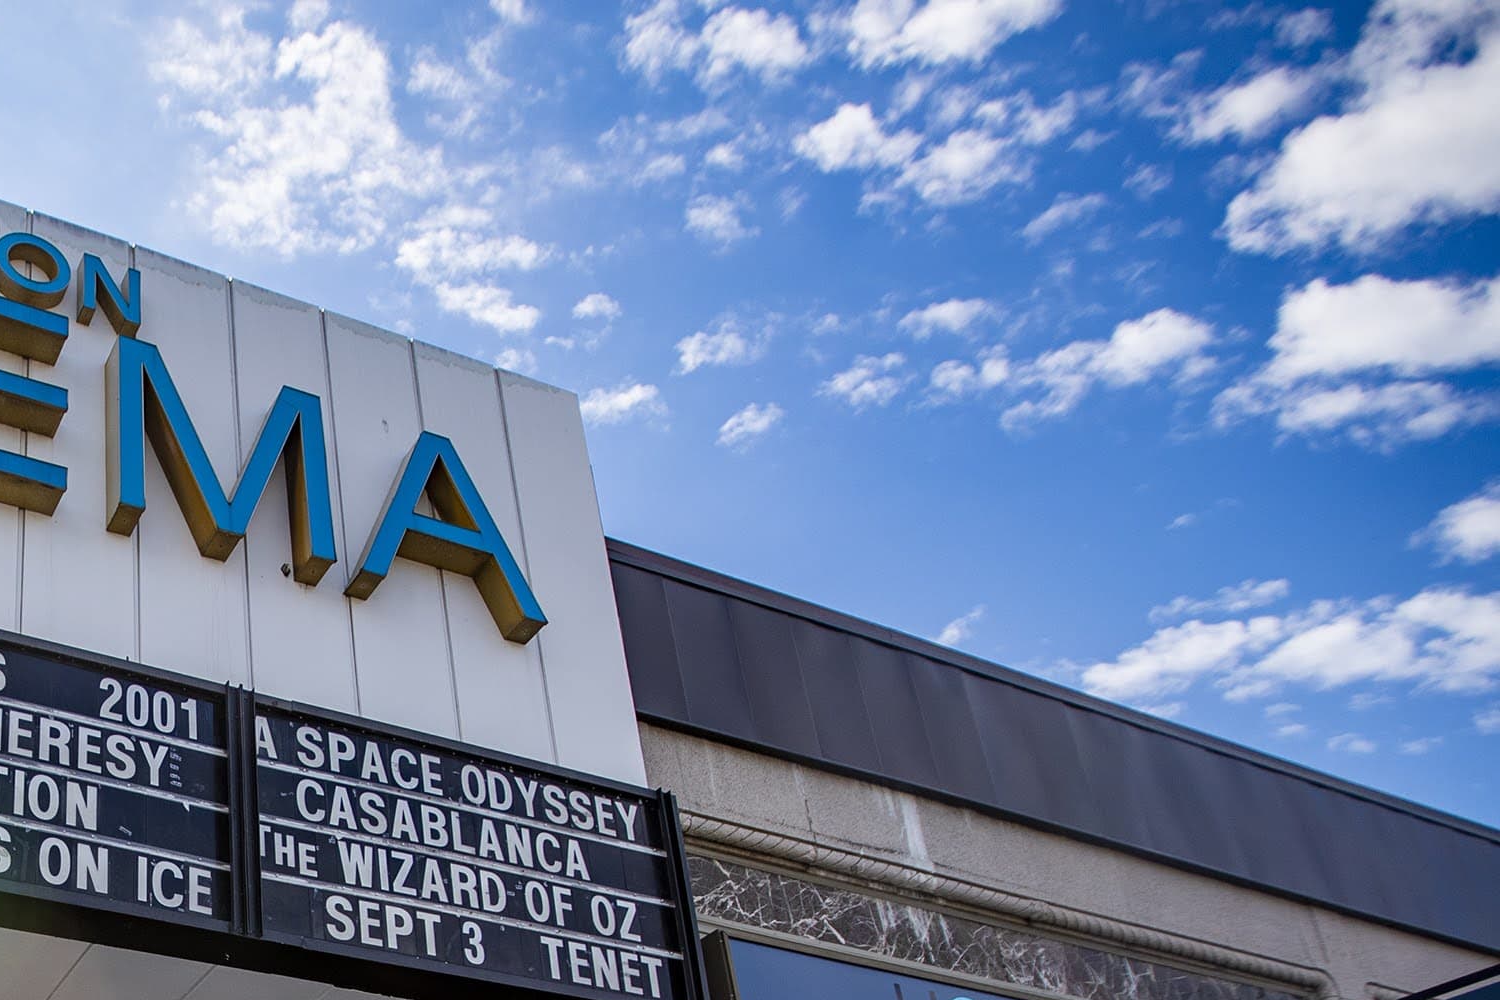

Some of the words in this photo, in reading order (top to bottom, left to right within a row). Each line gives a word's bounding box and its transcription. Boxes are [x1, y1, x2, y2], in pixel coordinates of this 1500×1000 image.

[99, 677, 198, 740] 2001
[255, 715, 278, 759] A
[296, 726, 444, 796] SPACE
[461, 764, 637, 841] ODYSSEY
[259, 824, 318, 878] THE
[337, 840, 507, 913] WIZARD
[524, 880, 573, 927] OF
[590, 895, 642, 943] OZ
[296, 778, 591, 882] CASABLANCA
[39, 837, 109, 895] ON
[137, 855, 213, 915] ICE
[325, 895, 441, 957] SEPT
[462, 921, 486, 966] 3
[540, 935, 662, 999] TENET
